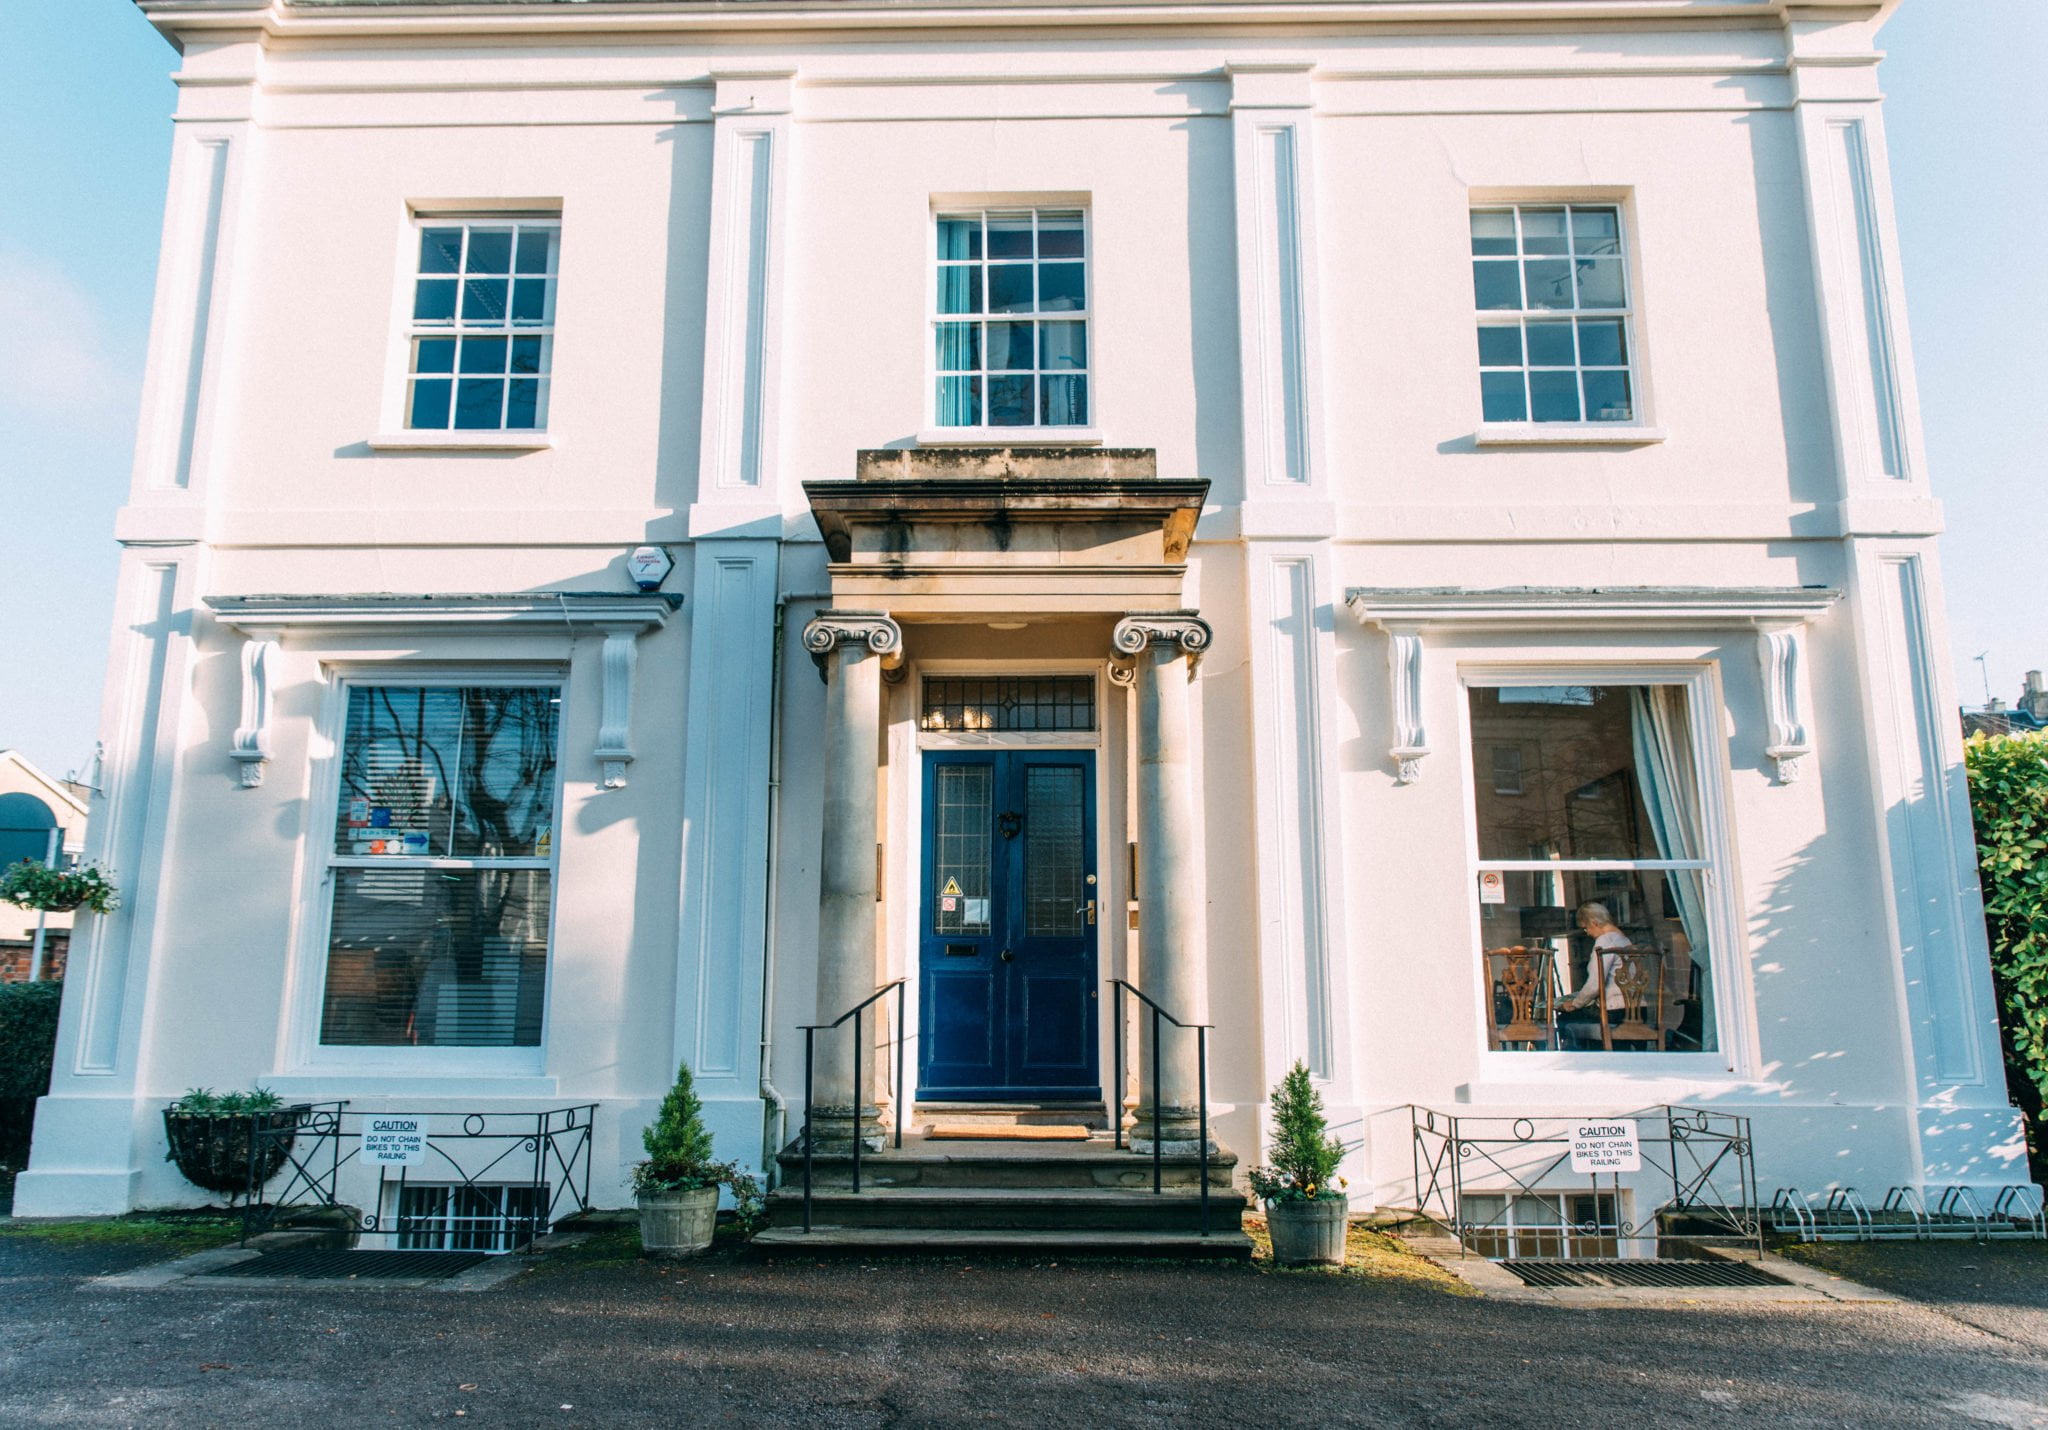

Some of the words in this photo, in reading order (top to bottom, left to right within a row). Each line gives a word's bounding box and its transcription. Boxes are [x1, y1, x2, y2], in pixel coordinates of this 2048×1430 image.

[373, 1120, 418, 1130] CAUTION
[1579, 1126, 1625, 1136] CAUTION
[366, 1135, 378, 1143] DO
[404, 1144, 420, 1152] THIS
[1575, 1142, 1587, 1150] DO
[1589, 1141, 1605, 1149] NOT
[377, 1152, 407, 1160] RAILING
[1576, 1150, 1599, 1158] BIKES
[1615, 1149, 1633, 1157] THIS
[1590, 1158, 1621, 1166] RAILING
